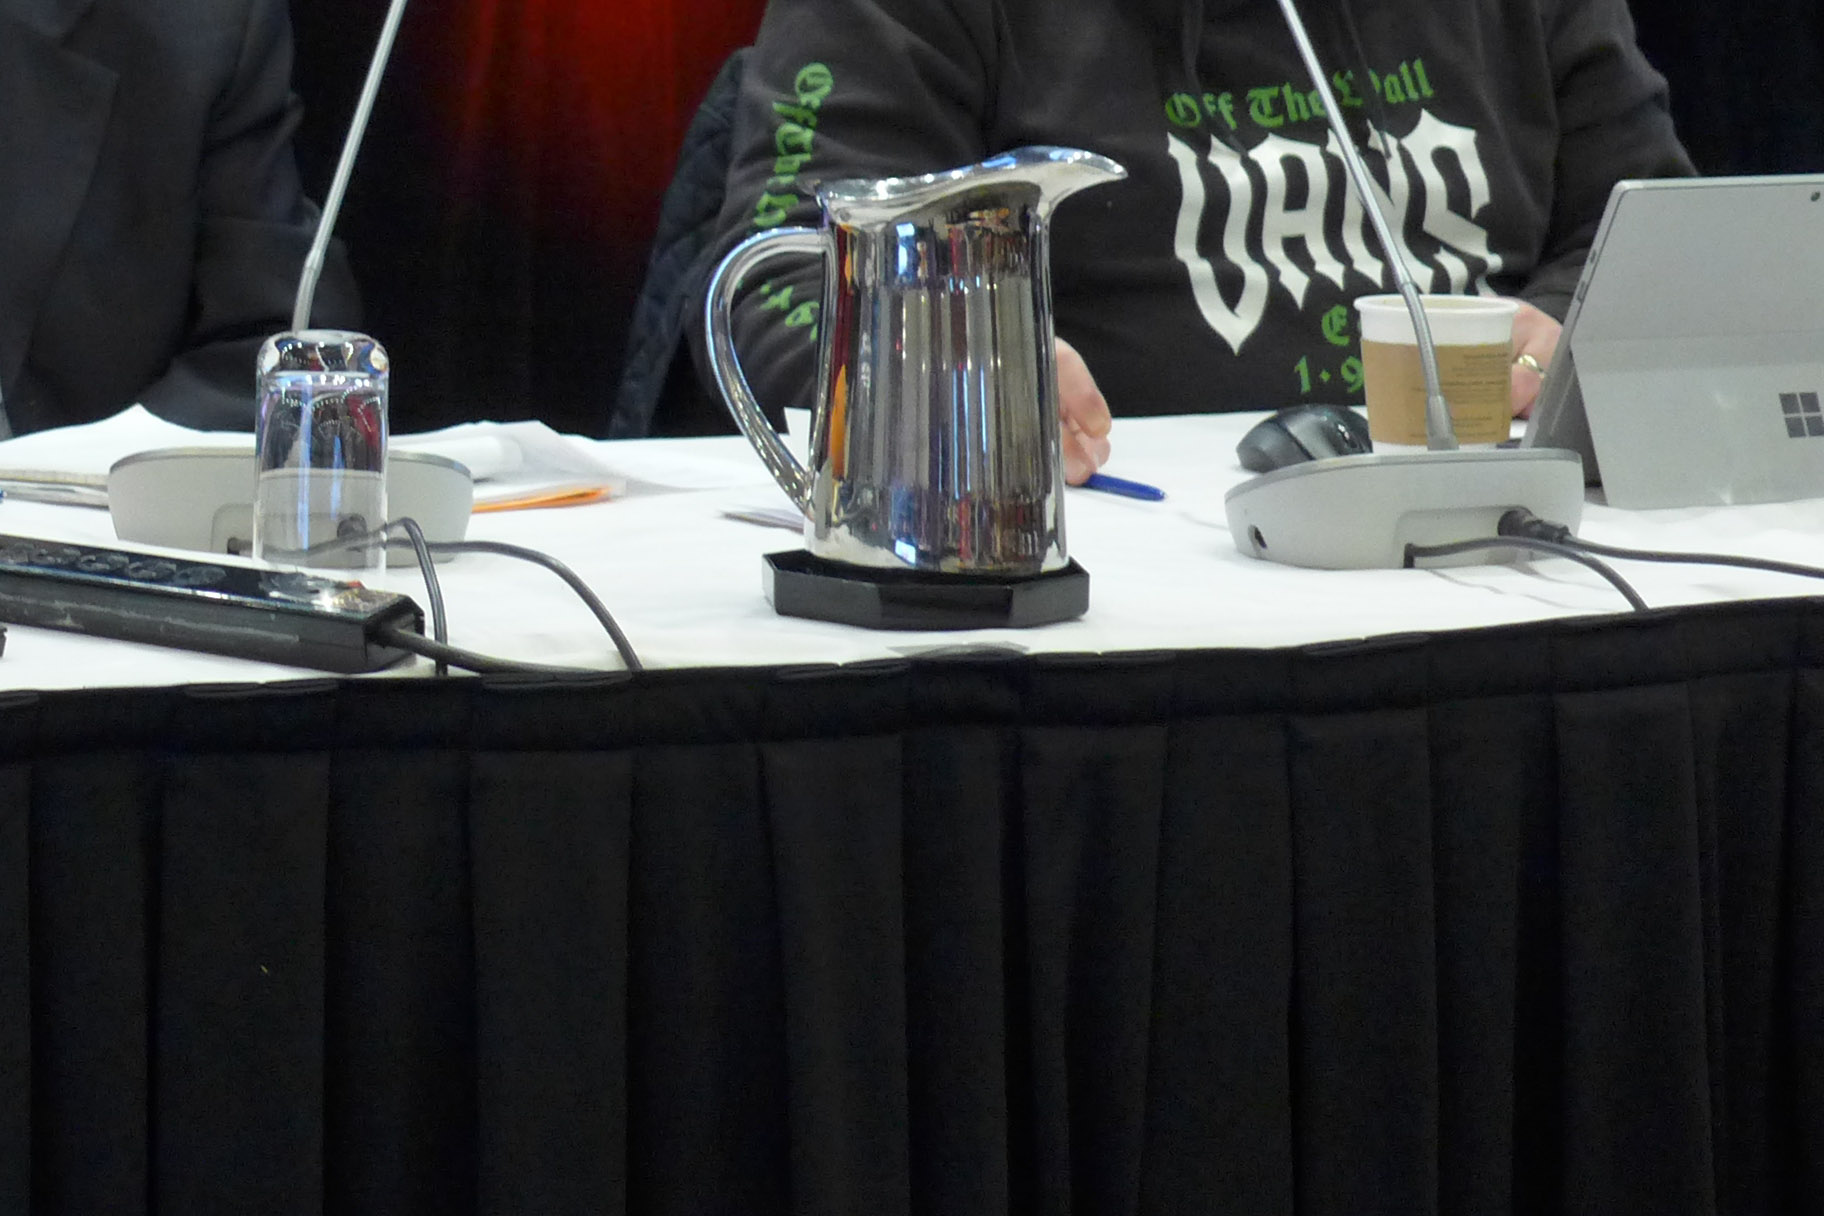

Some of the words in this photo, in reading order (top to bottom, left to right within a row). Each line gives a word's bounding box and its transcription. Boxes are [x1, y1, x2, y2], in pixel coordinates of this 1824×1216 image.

[1165, 92, 1238, 131] Off
[1246, 82, 1327, 128] The
[1167, 107, 1504, 357] VANS
[1321, 304, 1361, 346] E
